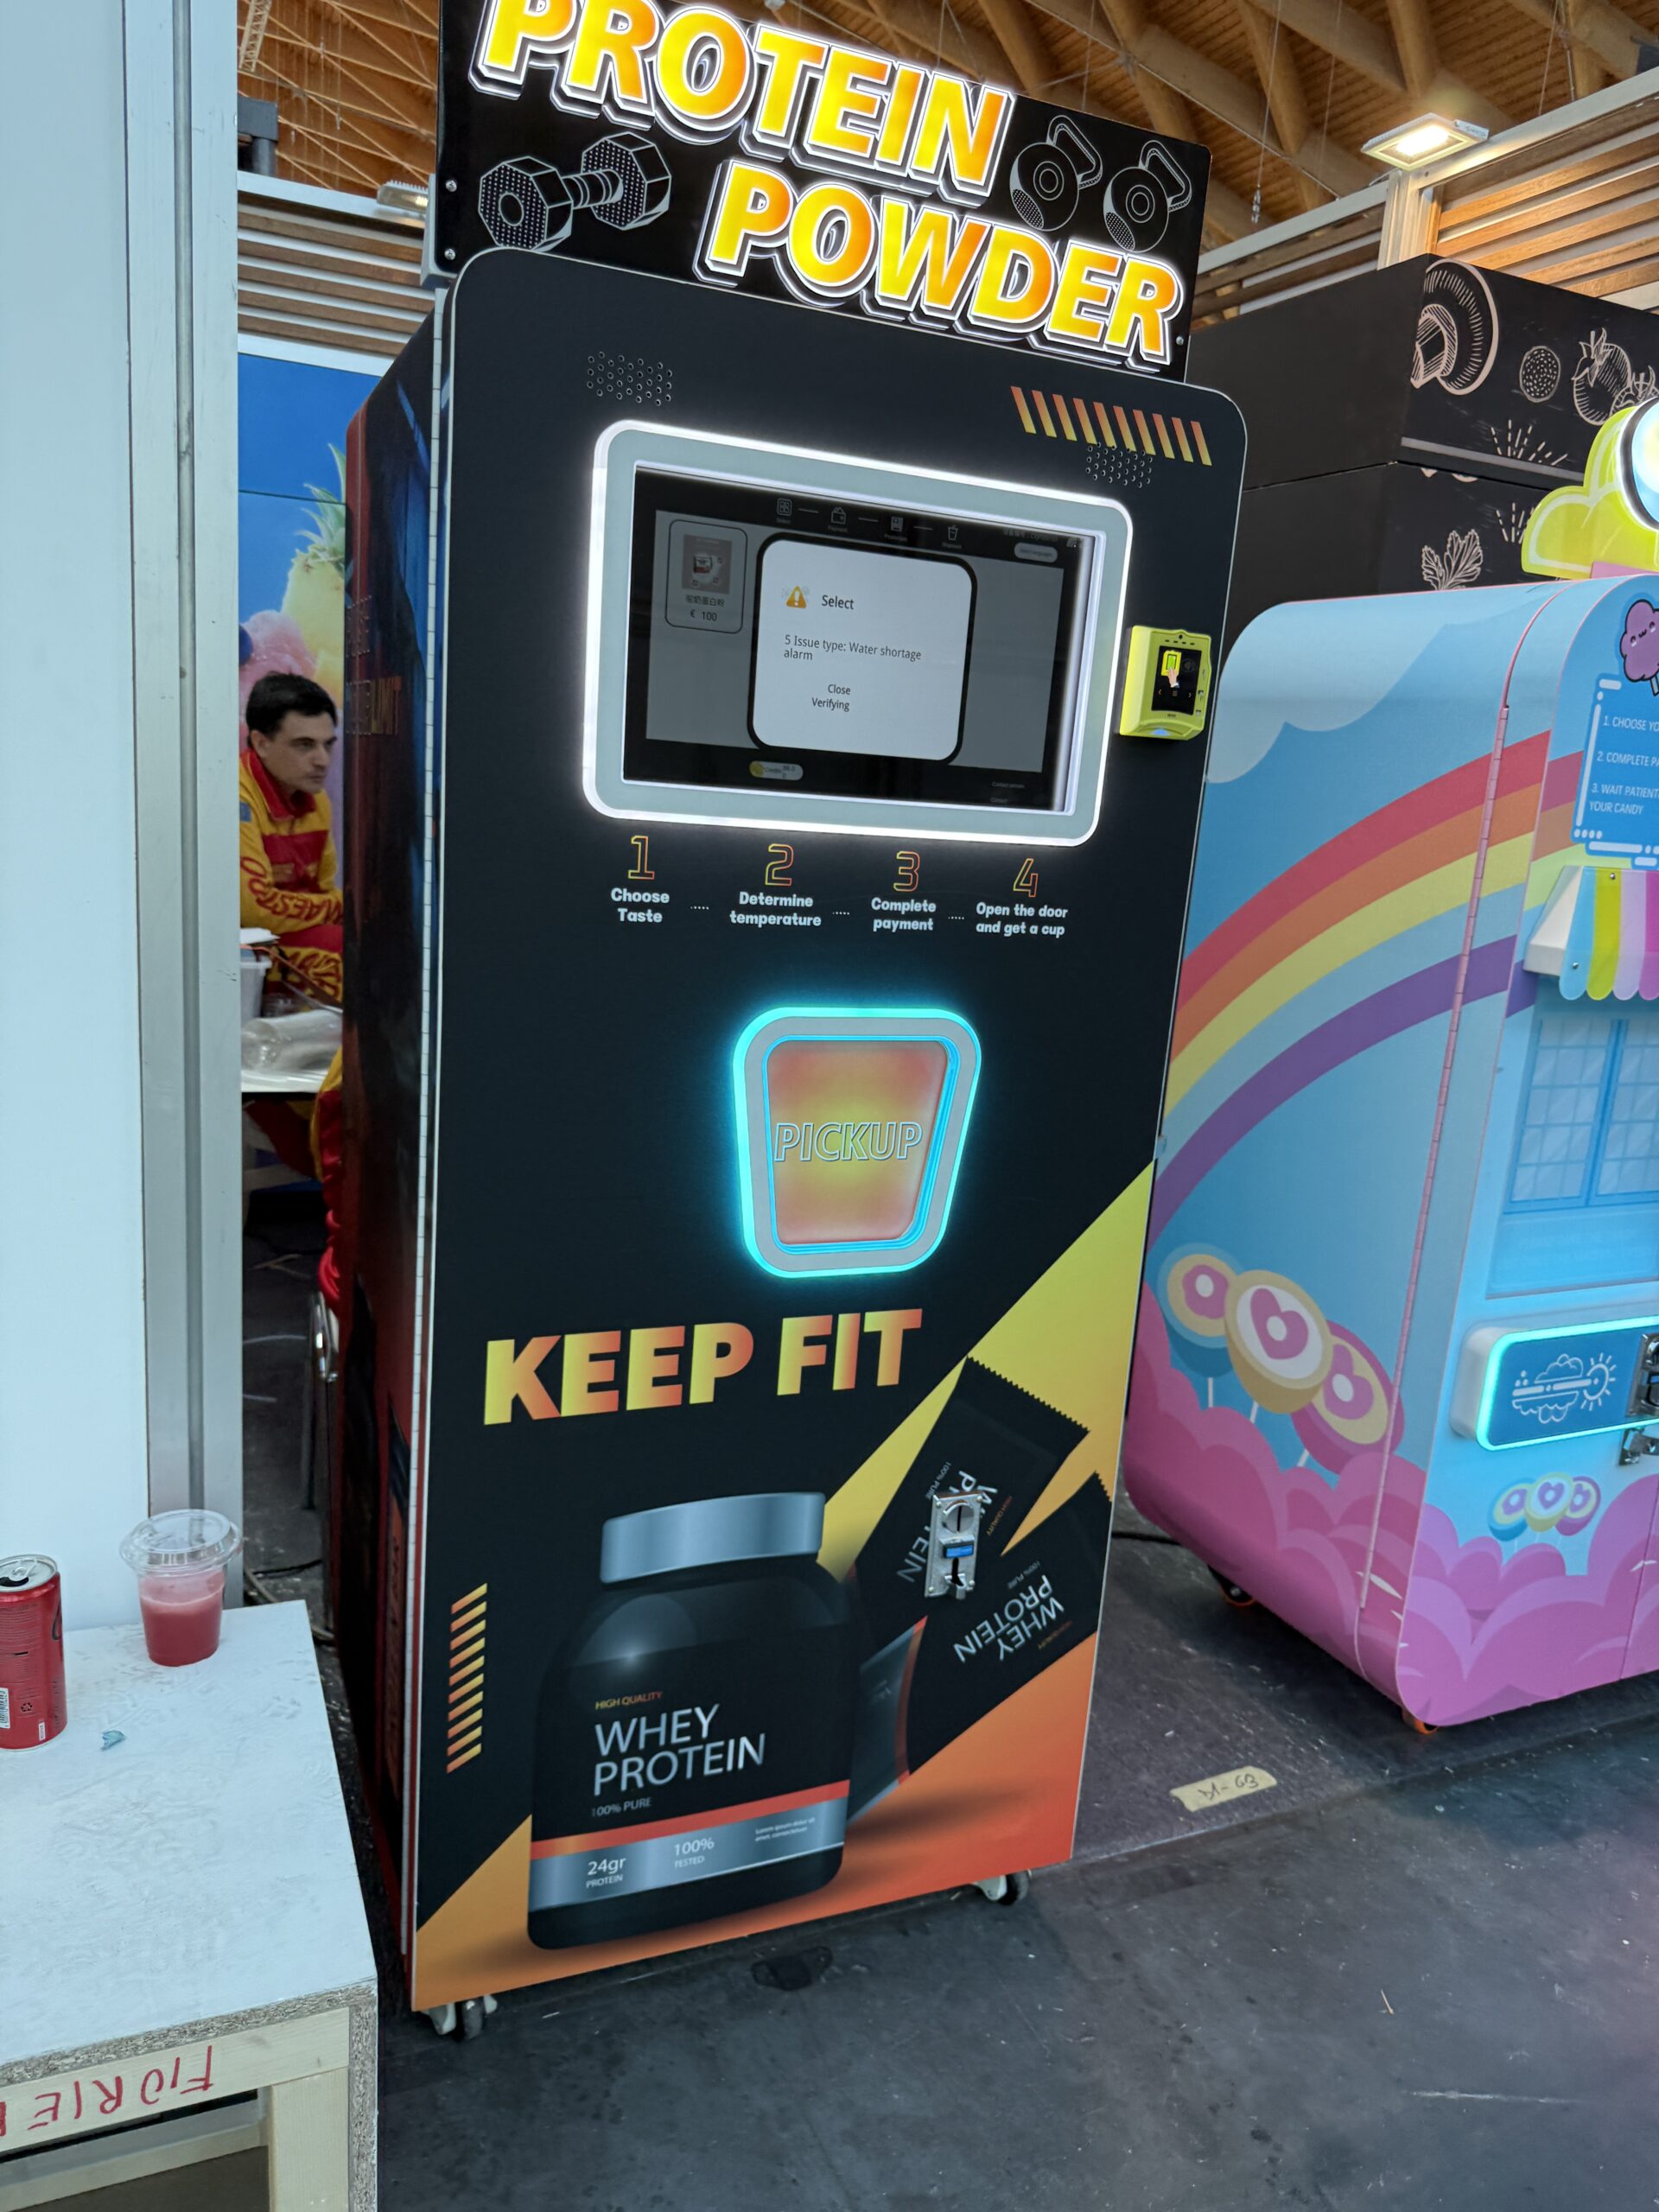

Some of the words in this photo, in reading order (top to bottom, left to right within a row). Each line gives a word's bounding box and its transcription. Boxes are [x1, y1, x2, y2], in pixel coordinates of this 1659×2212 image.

[467, 0, 1018, 207] PROTEIN
[694, 157, 1185, 372] POWDER
[821, 594, 855, 610] Select
[702, 611, 717, 621] 100
[784, 648, 813, 661] alarm
[785, 634, 791, 645] 5
[794, 635, 820, 649] Issue
[823, 639, 846, 653] type:
[849, 642, 878, 655] Water
[880, 645, 922, 663] shortage
[828, 683, 851, 696] Close
[811, 697, 850, 712] Verifying
[1611, 716, 1647, 731] CHOOSE
[1606, 752, 1649, 767] COMPLETE
[1601, 784, 1624, 796] WAIT
[1589, 801, 1613, 813] YOUR
[1614, 803, 1644, 815] CANDY
[628, 835, 655, 880] 1
[765, 842, 794, 887] 2
[893, 850, 920, 892] 3
[1013, 857, 1039, 898] 4
[610, 887, 670, 904] Choose
[739, 891, 814, 907] Determine
[871, 897, 937, 914] Complete
[976, 901, 1010, 918] Open
[1014, 903, 1035, 917] the
[1038, 905, 1068, 918] door
[617, 907, 663, 923] Taste
[729, 910, 822, 928] temperature
[873, 918, 933, 932] payment
[976, 921, 1001, 934] and
[1003, 921, 1027, 938] get
[1029, 925, 1039, 934] a
[1041, 925, 1065, 939] cup
[773, 1122, 923, 1162] PICKUP
[484, 1322, 753, 1426] KEEP
[777, 1308, 923, 1396] FIT
[953, 1574, 1053, 1663] PROTEIN
[996, 1597, 1065, 1662] WHEY
[594, 1697, 620, 1710] HIGH
[621, 1691, 663, 1706] QUALITY
[594, 1703, 720, 1757] WHEY
[593, 1732, 766, 1796] PROTEIN
[592, 1802, 621, 1817] 100%
[623, 1796, 652, 1812] PURE
[674, 1837, 715, 1856] 100%
[587, 1857, 626, 1876] 24gr
[674, 1855, 705, 1869] TESTED
[586, 1874, 623, 1889] PROTEIN
[0, 2045, 213, 2136] FIORIE
